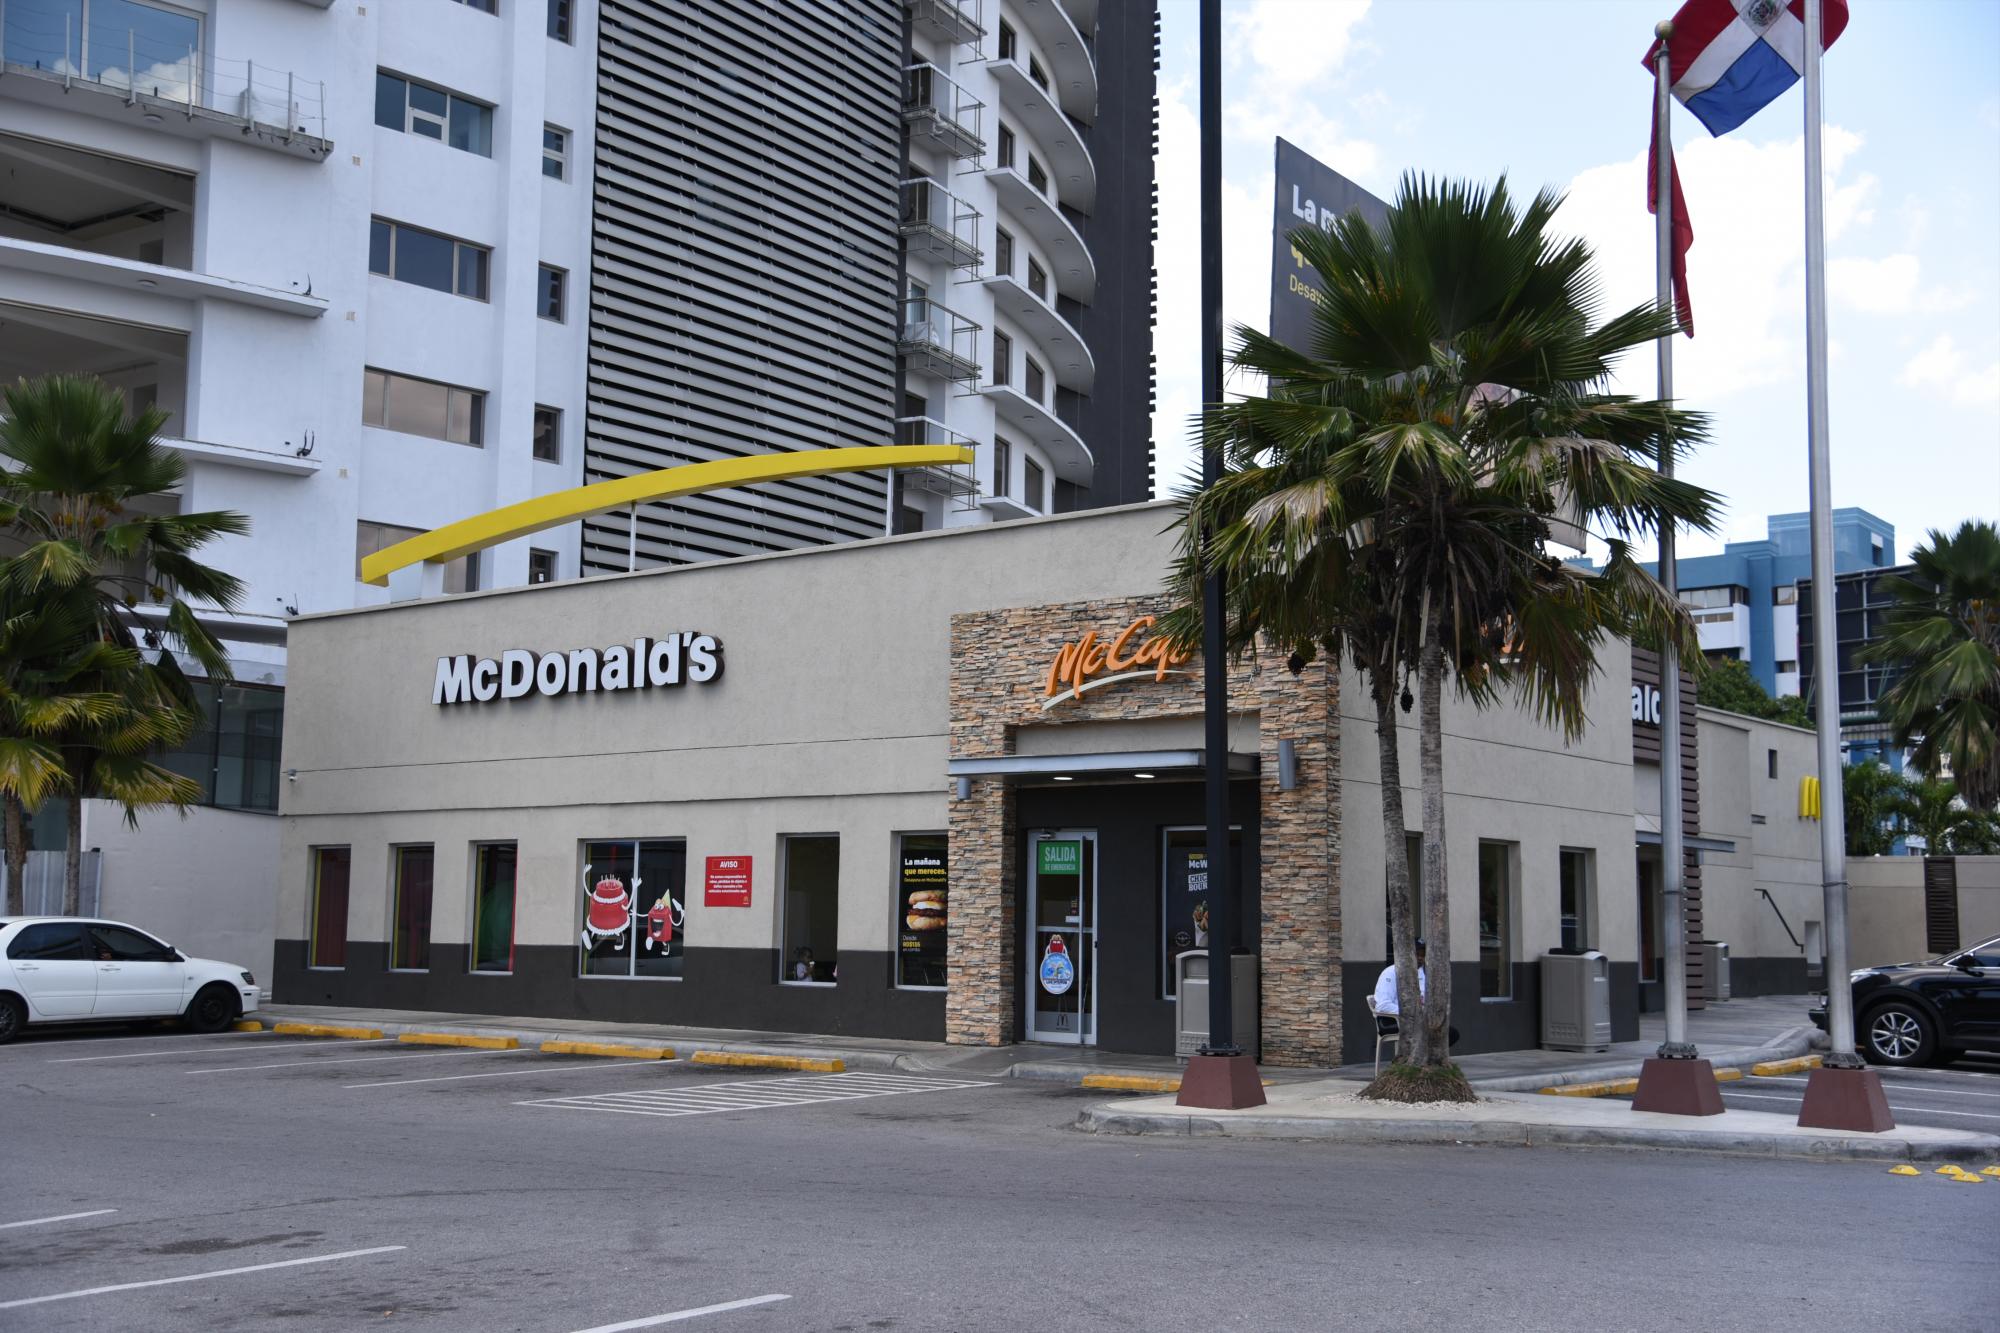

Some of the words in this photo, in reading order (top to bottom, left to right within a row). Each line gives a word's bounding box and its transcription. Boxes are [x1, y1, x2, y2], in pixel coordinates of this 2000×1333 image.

[1292, 184, 1316, 225] La
[432, 631, 724, 704] McDonald's
[1045, 846, 1076, 862] SALIDA
[720, 861, 738, 869] AVISO
[904, 858, 913, 866] La
[914, 857, 941, 866] mañana
[1188, 859, 1208, 869] McW
[904, 868, 916, 876] que
